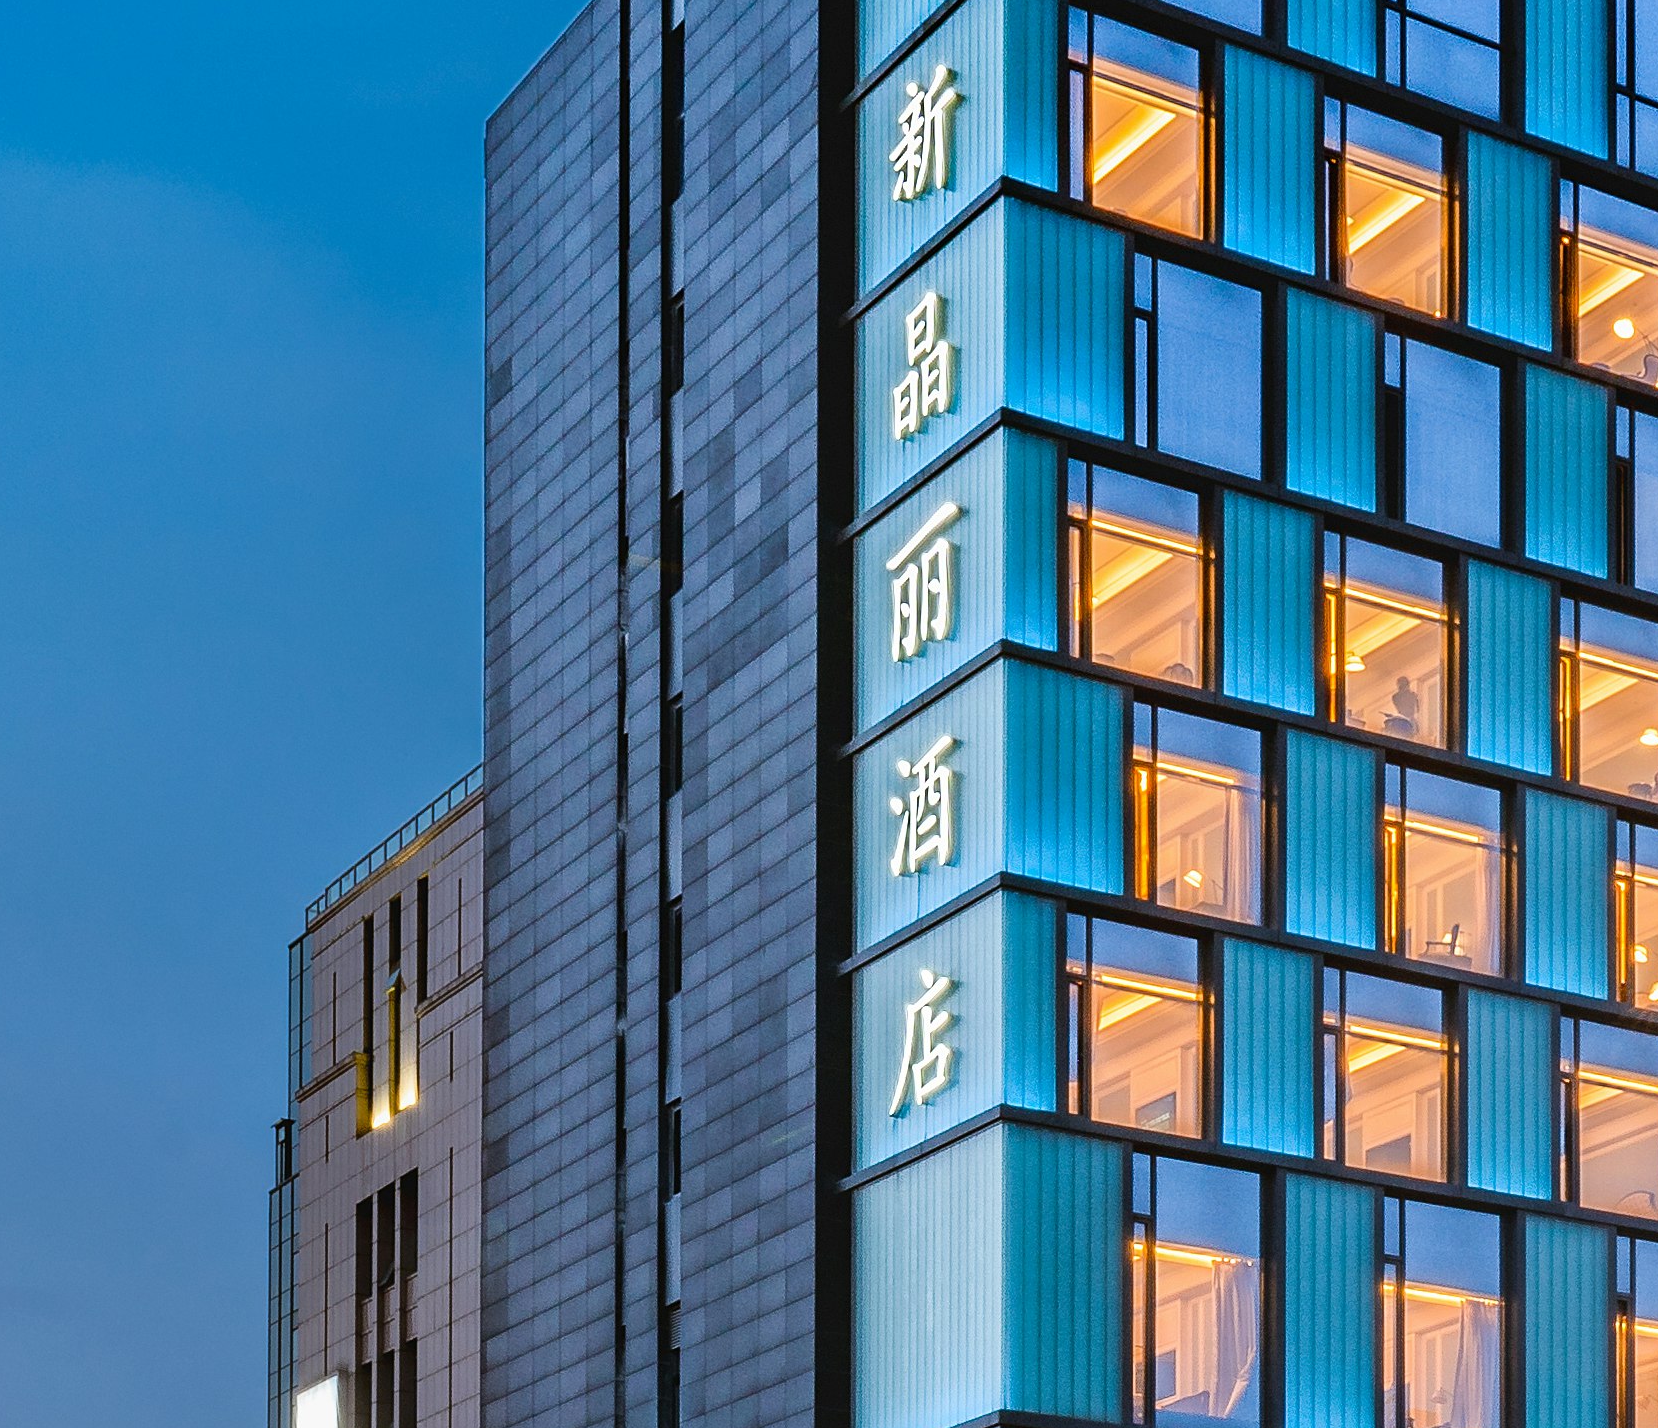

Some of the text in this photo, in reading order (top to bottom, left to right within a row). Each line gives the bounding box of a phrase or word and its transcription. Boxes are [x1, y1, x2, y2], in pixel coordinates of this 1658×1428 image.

[887, 64, 959, 1116] 新晶丽酒店
